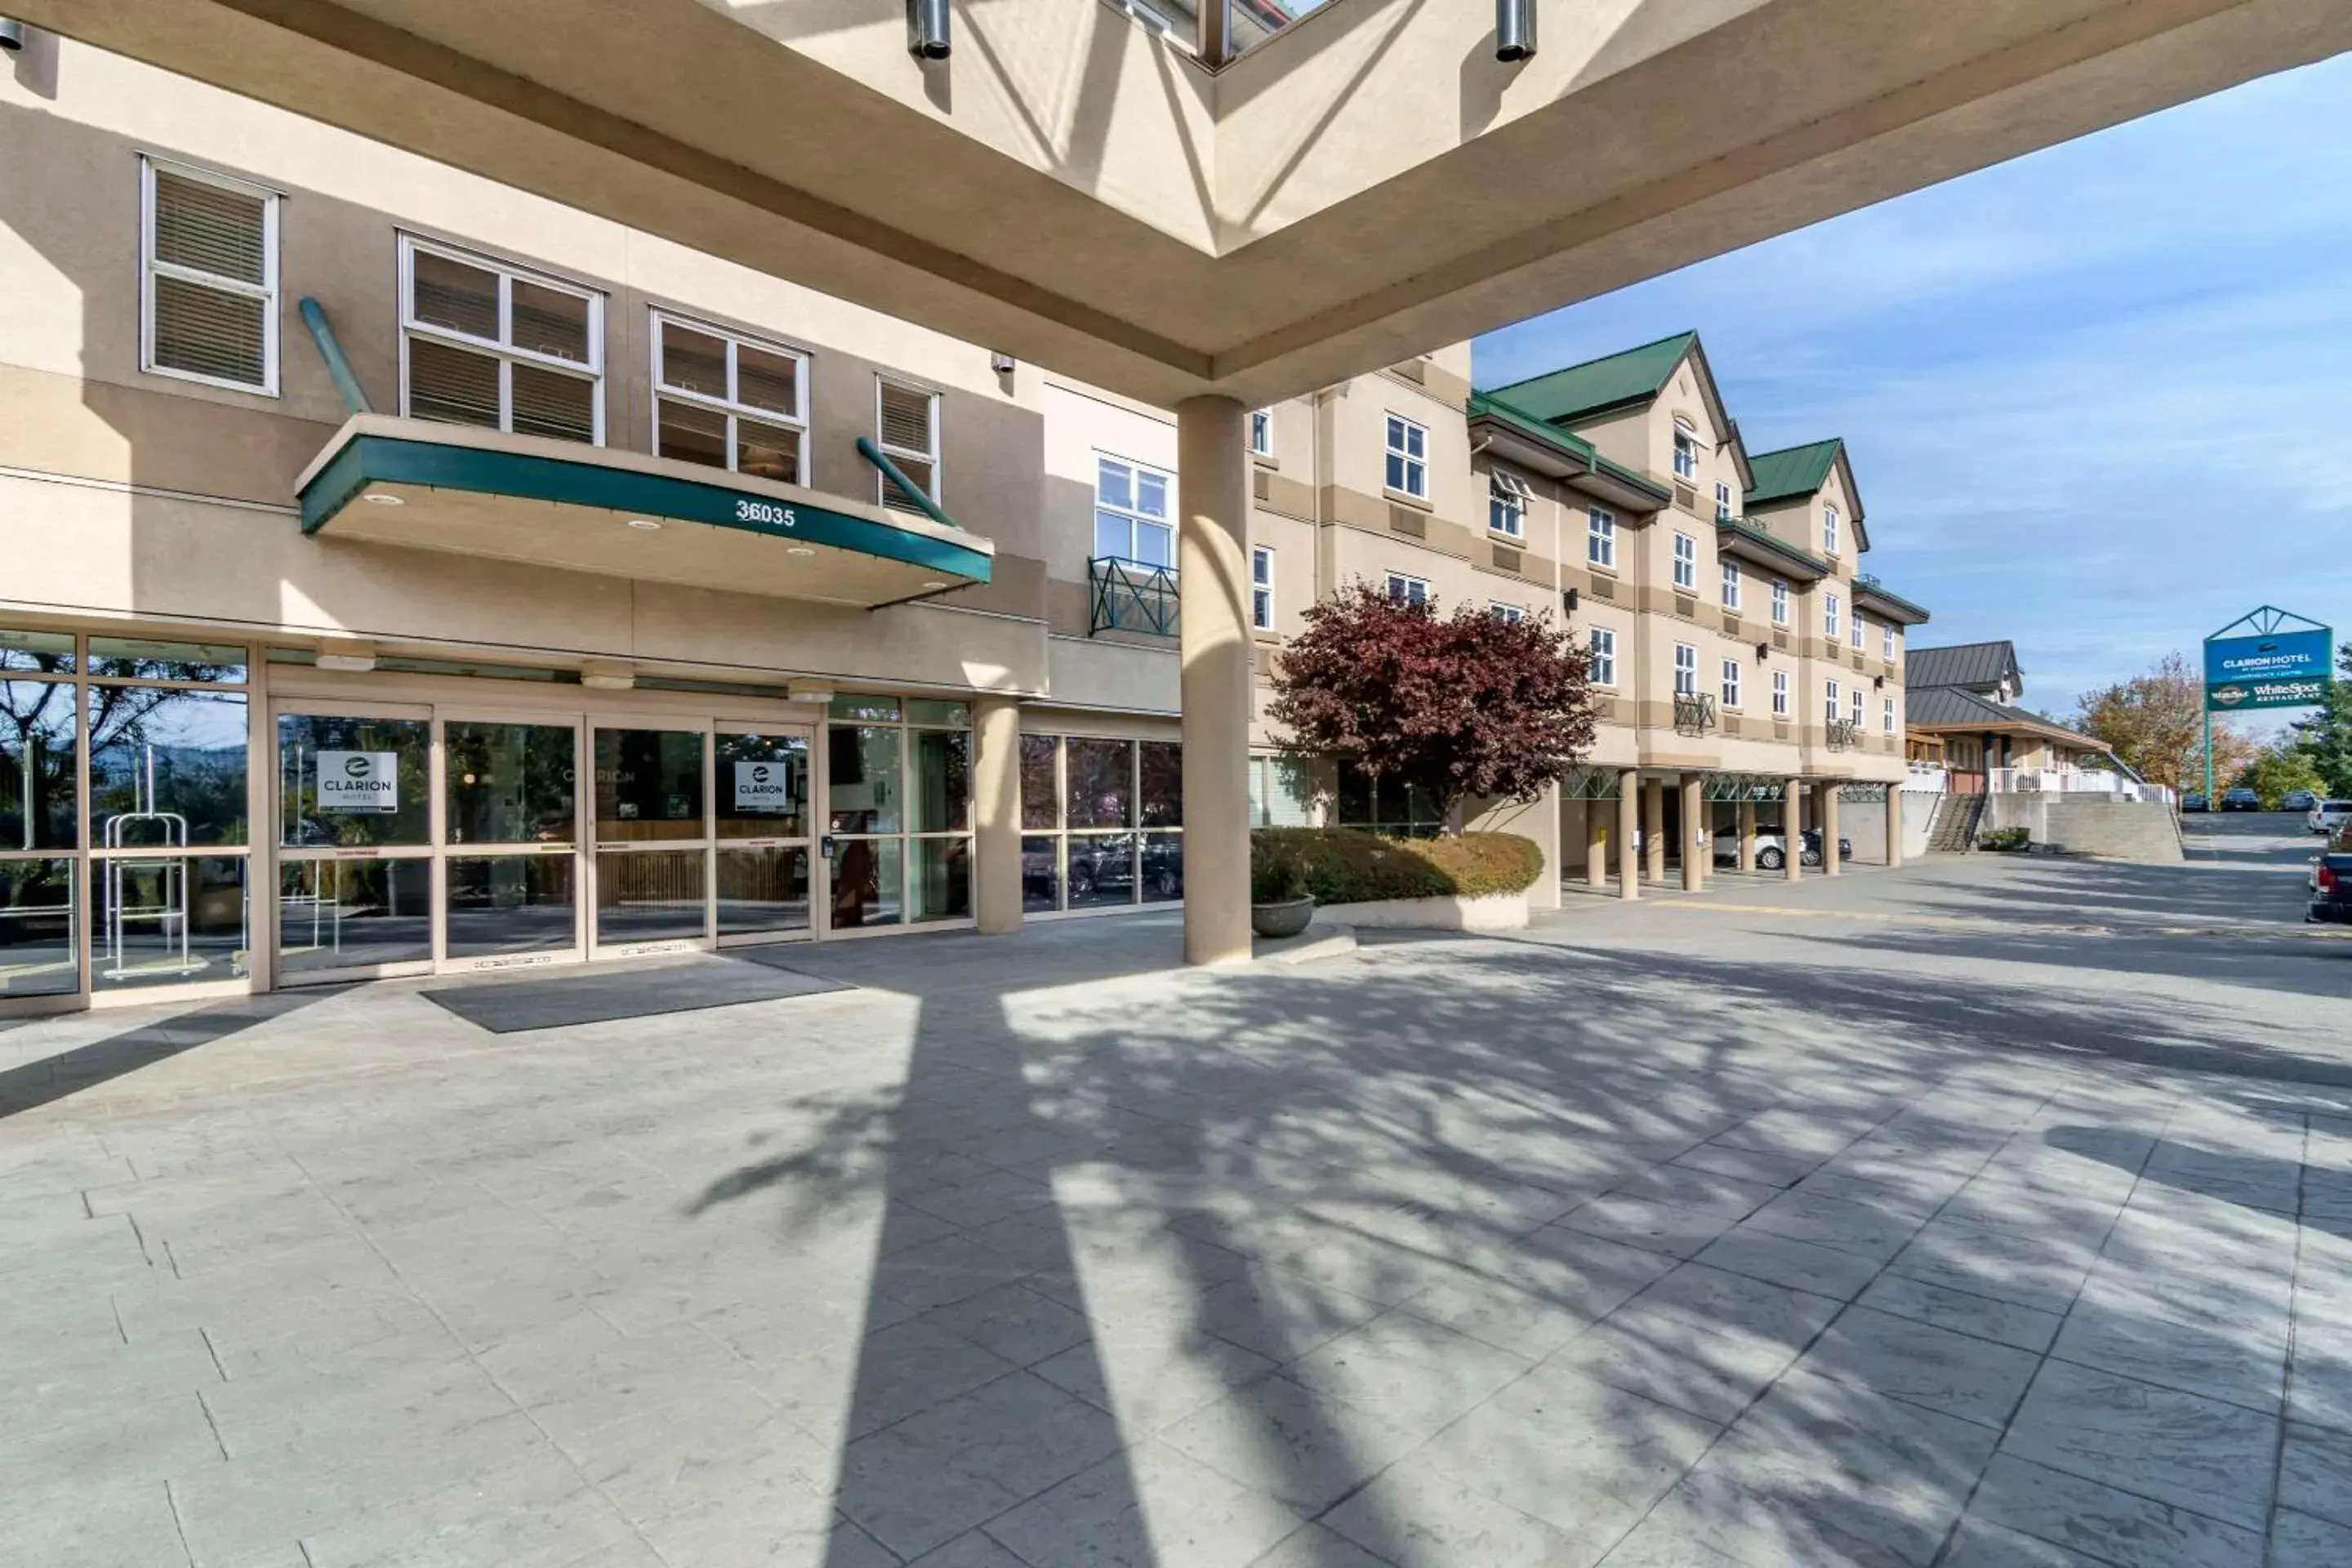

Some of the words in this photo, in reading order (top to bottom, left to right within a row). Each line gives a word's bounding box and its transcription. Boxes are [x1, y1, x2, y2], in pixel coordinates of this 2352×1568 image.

[736, 500, 795, 527] 36035
[2223, 657, 2270, 669] CLARION
[2271, 653, 2311, 665] HOTEL
[563, 768, 635, 782] CRION
[323, 780, 391, 791] CLARION
[739, 785, 782, 794] CLARION
